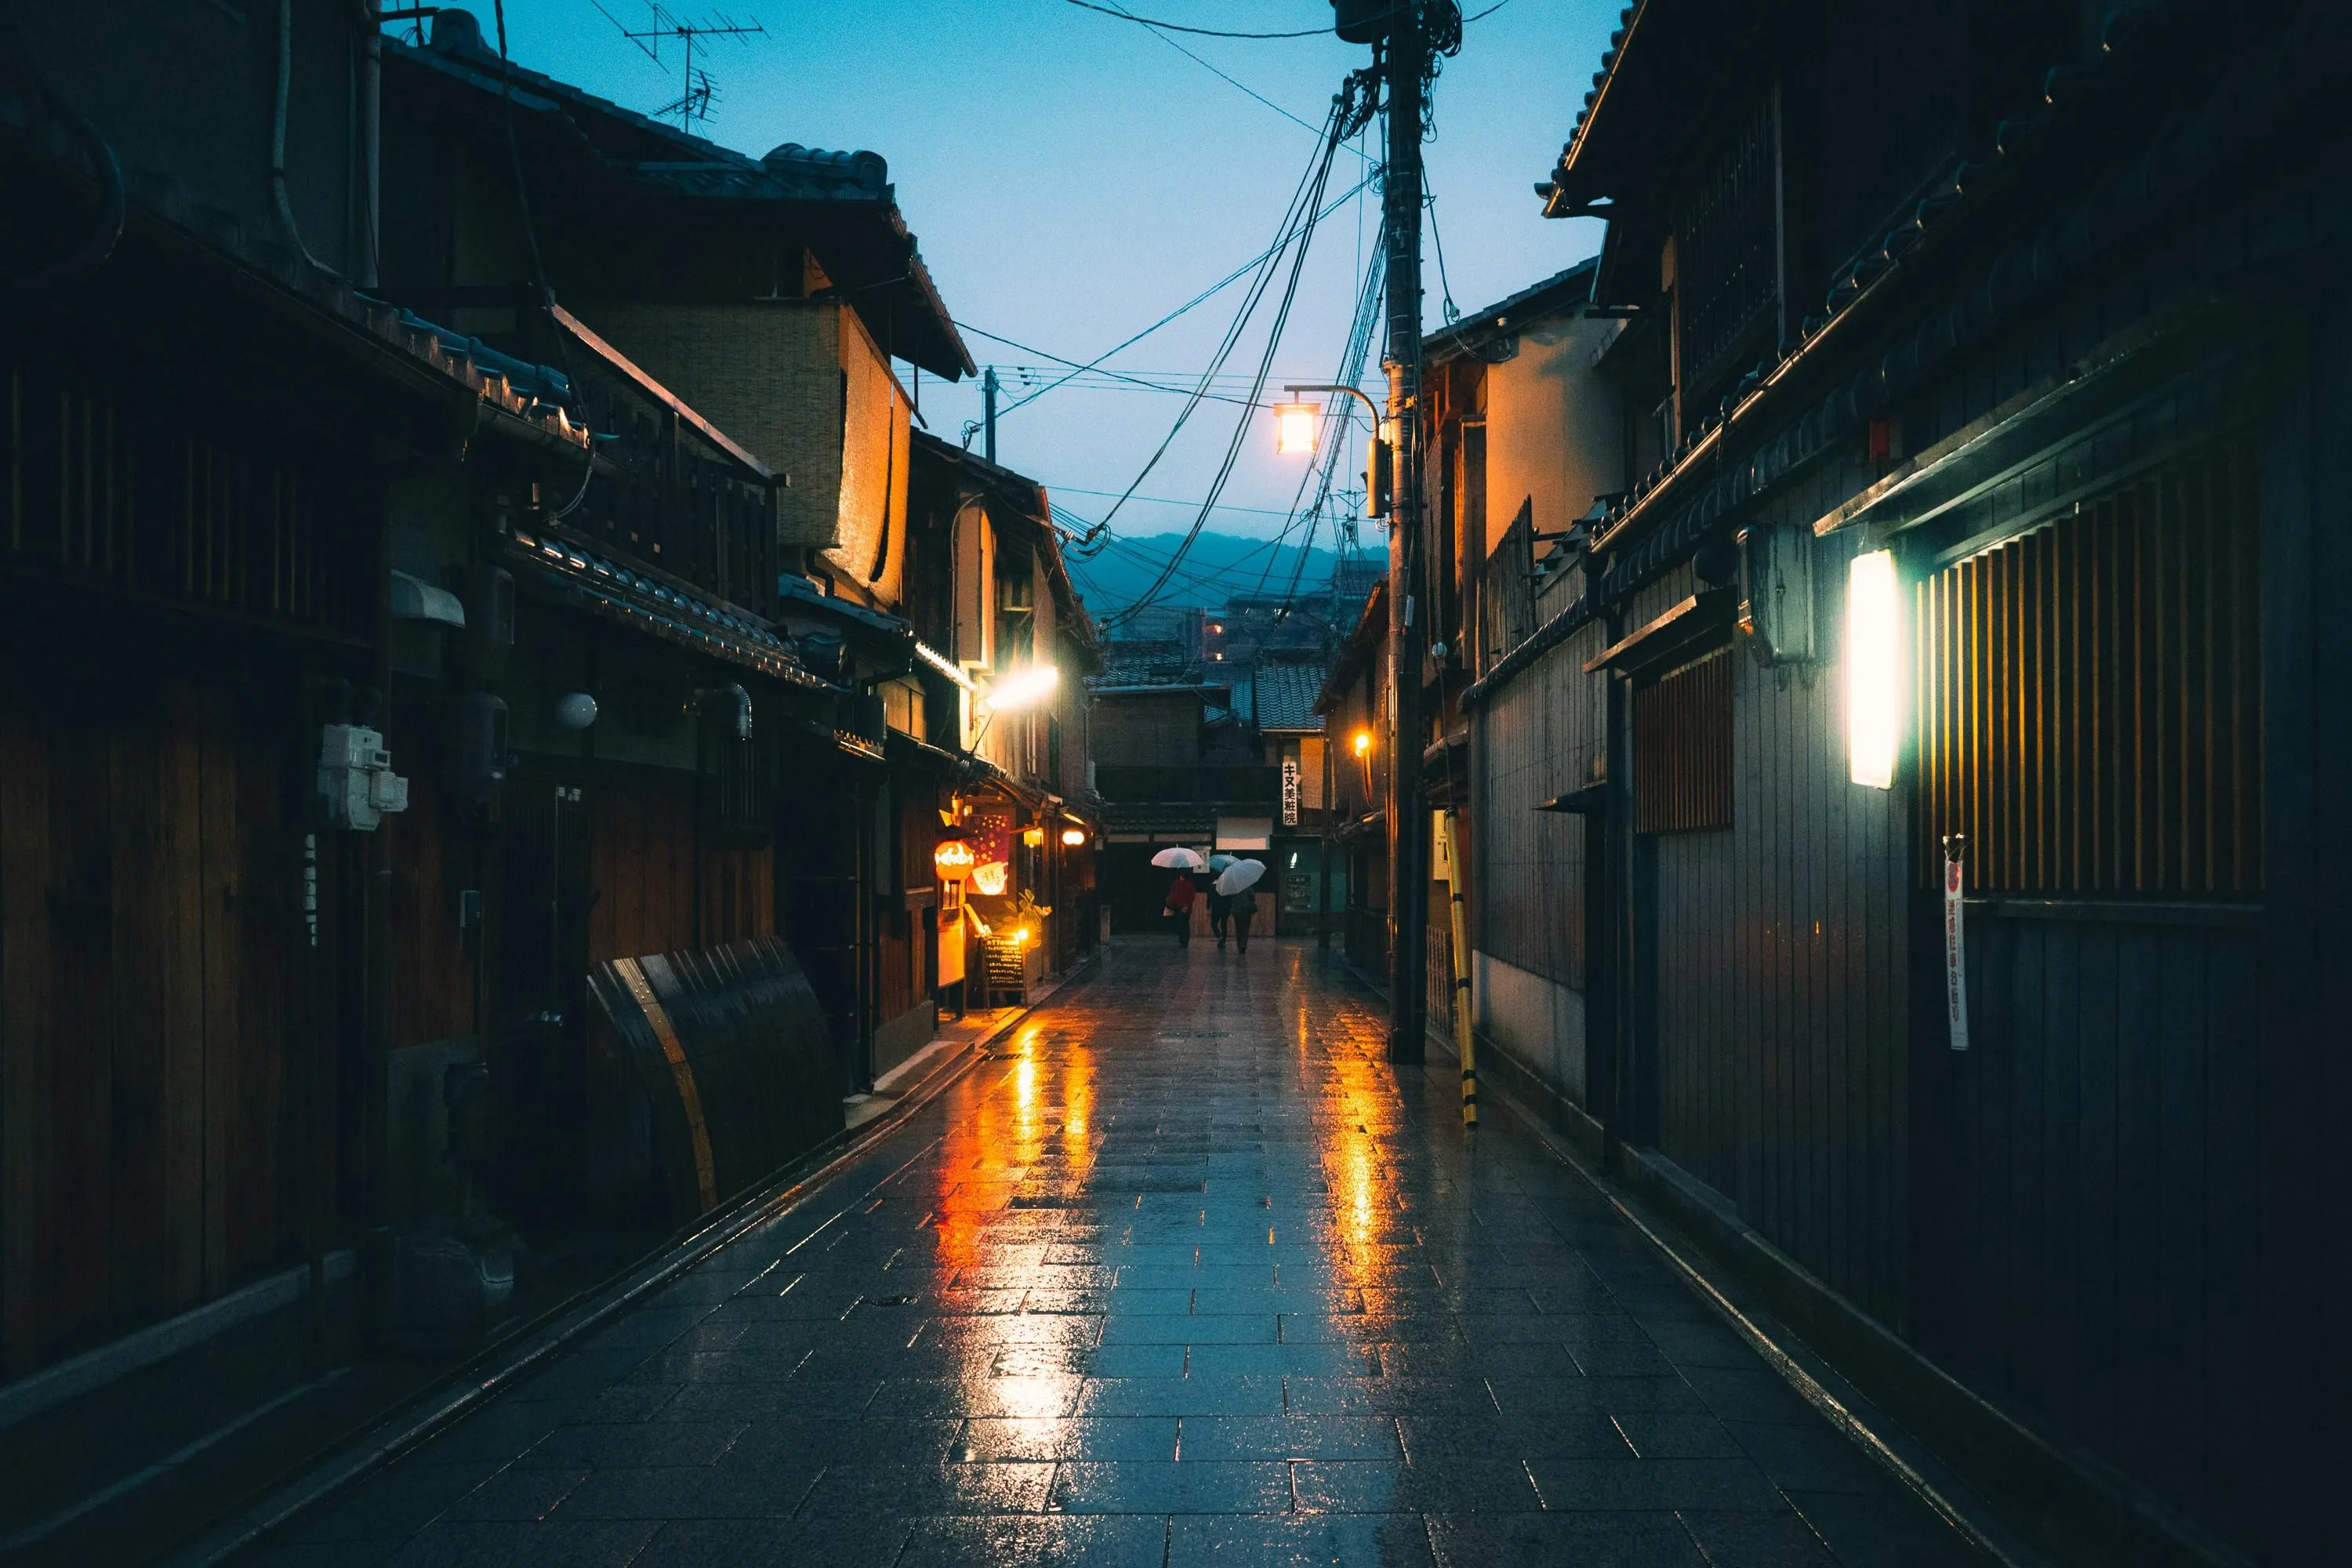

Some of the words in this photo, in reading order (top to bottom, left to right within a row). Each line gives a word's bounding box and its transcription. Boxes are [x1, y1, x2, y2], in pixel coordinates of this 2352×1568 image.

[1283, 764, 1296, 824] キヌ美粧院
